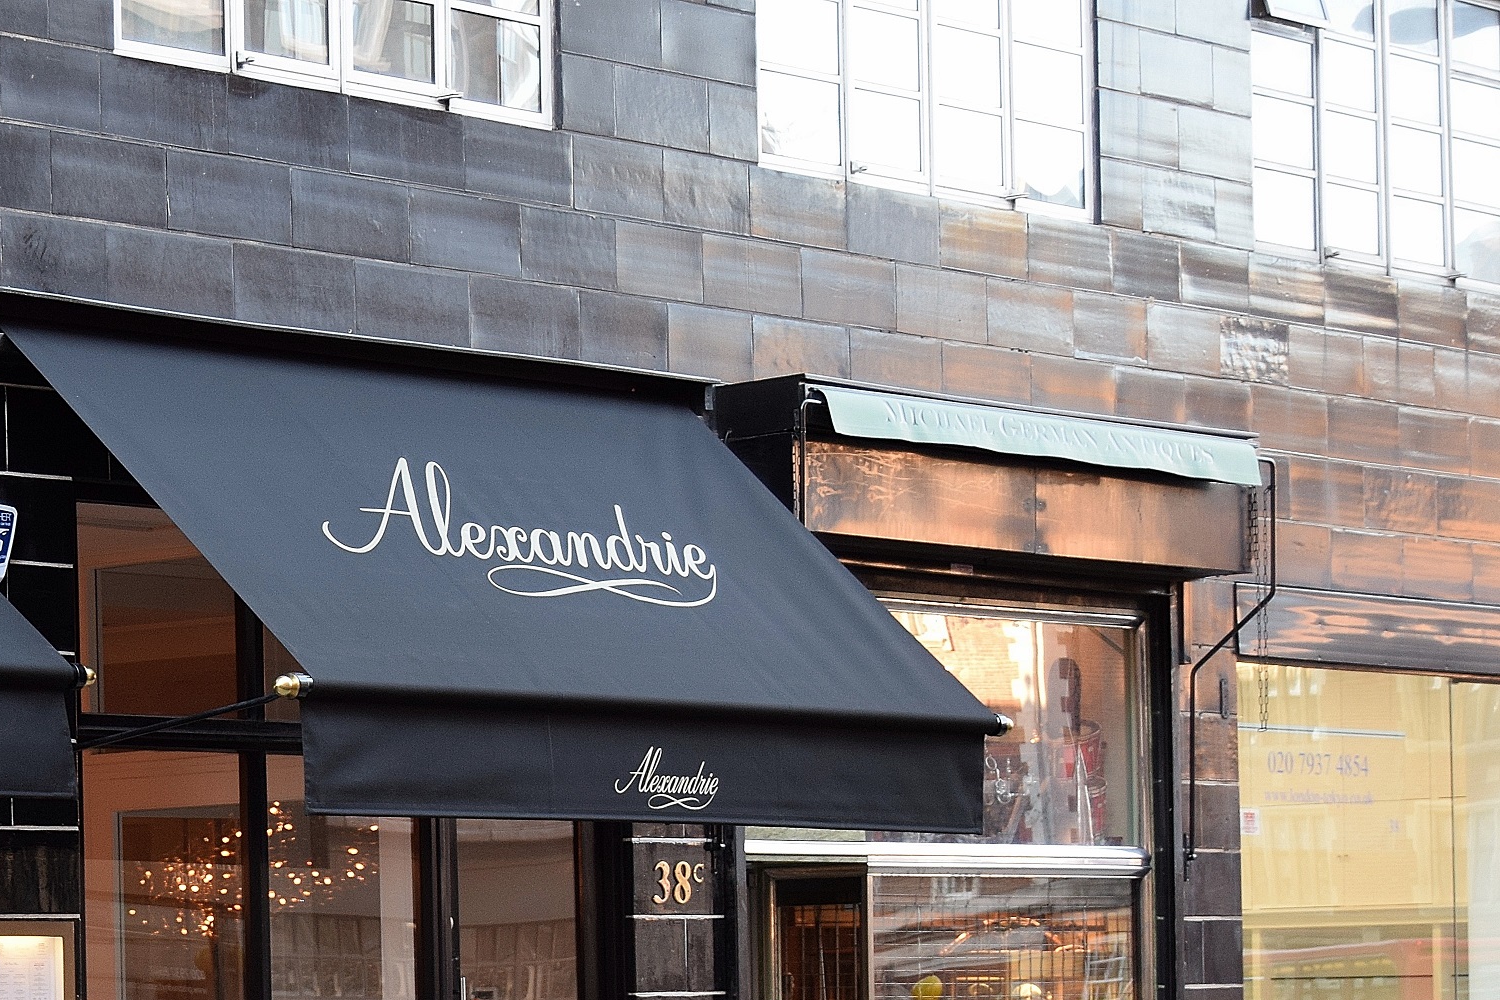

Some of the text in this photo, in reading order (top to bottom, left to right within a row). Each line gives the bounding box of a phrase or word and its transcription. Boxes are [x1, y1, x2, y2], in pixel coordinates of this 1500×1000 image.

[885, 401, 1215, 464] MICHAEL GERMAN ANTIQUES
[322, 457, 717, 608] Alexandrie
[615, 746, 719, 810] Alexandrie
[1267, 751, 1369, 777] 020 7937 4854
